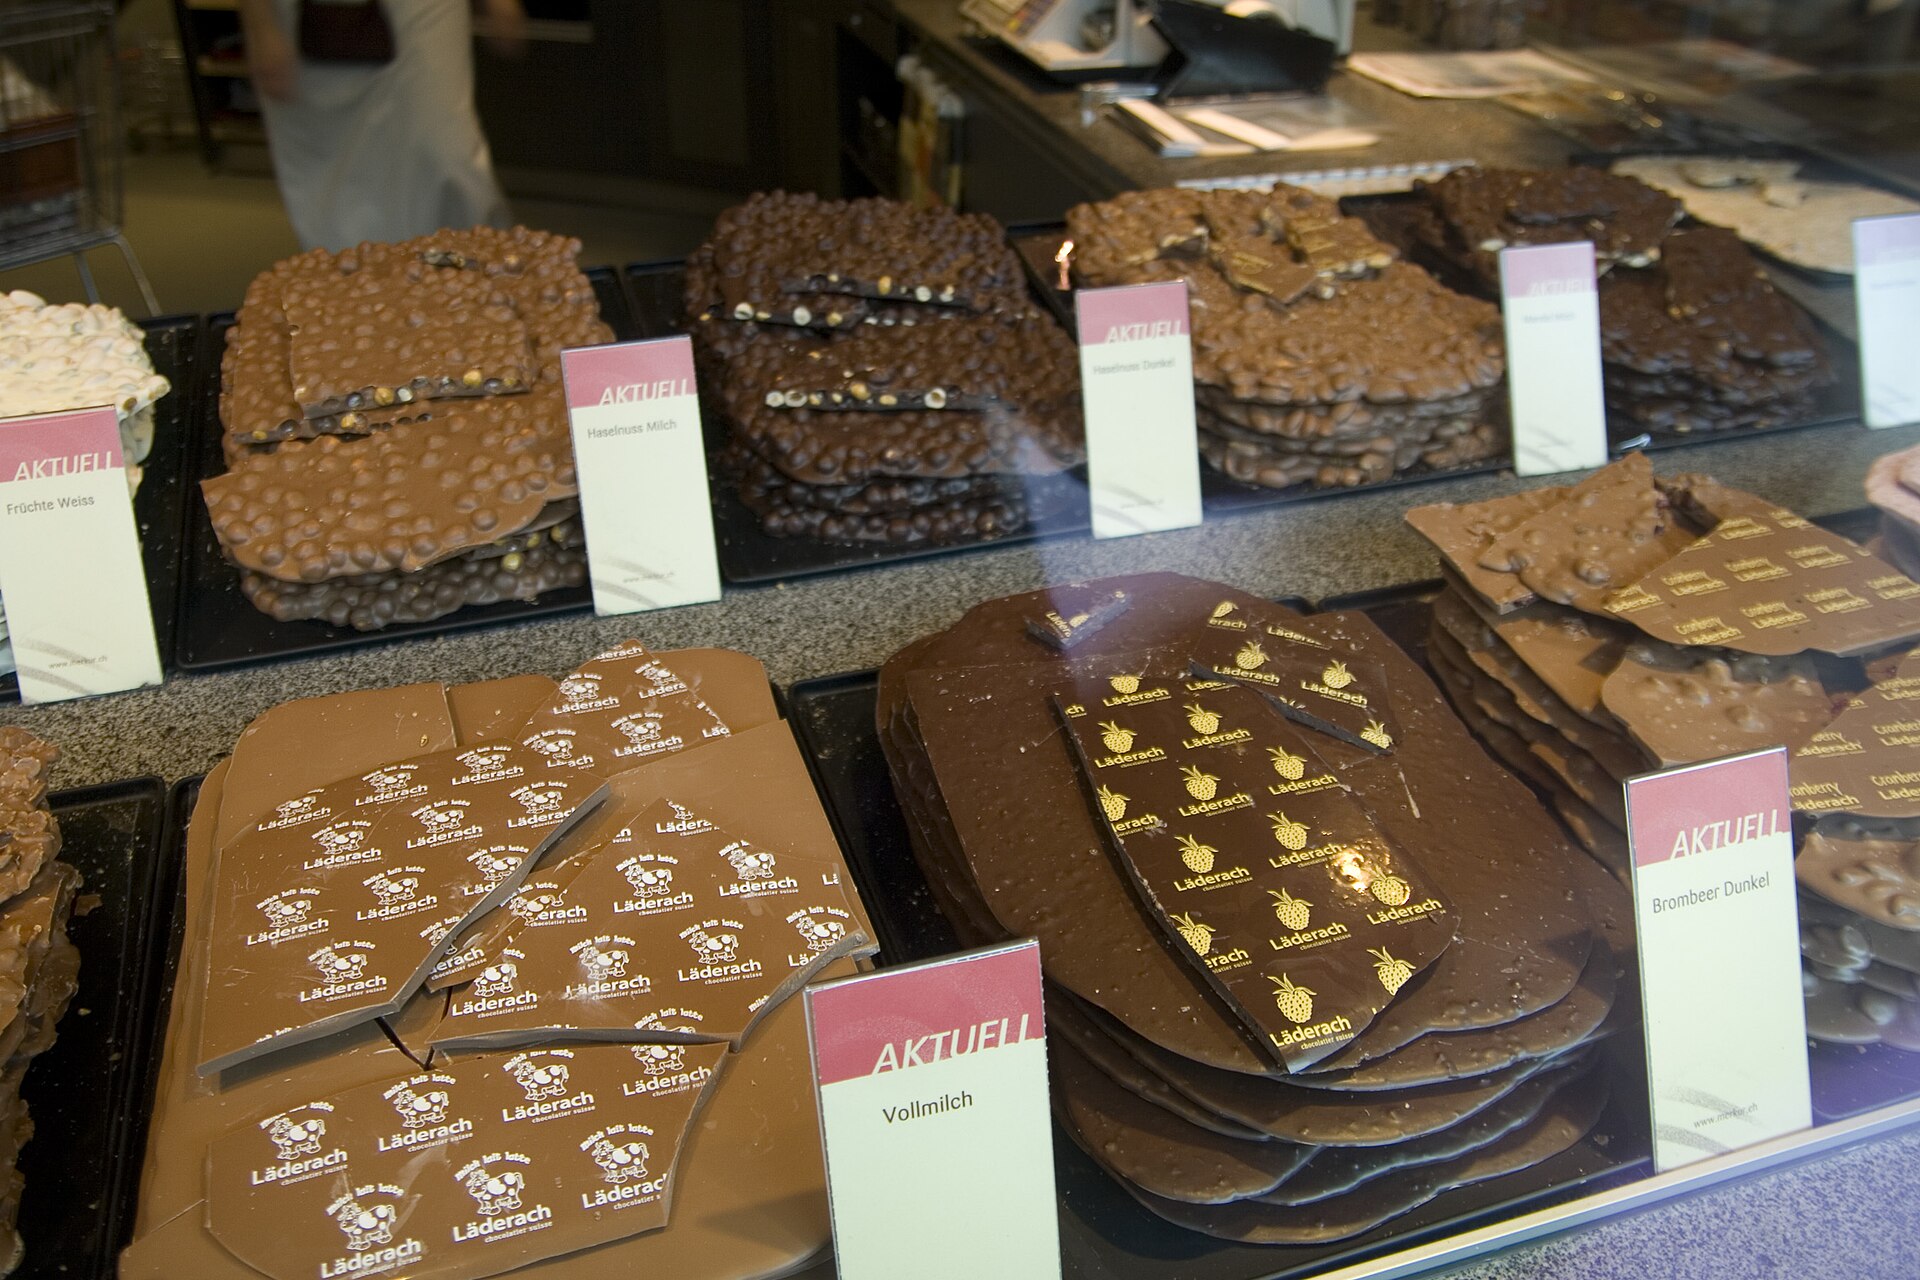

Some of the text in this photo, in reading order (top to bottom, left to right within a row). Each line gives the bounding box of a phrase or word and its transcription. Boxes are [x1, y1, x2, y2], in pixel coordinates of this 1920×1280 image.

[1105, 320, 1181, 344] AKTUELL
[599, 378, 688, 406] AKTUELL
[587, 419, 677, 439] Haselnuss Milch
[14, 451, 113, 481] AKTUELL
[7, 494, 95, 516] Früchte Weiss
[1046, 612, 1072, 638] Lädera
[1208, 618, 1248, 630] erach
[1267, 625, 1324, 645] Läder
[594, 646, 642, 661] derach
[1213, 665, 1280, 684] Läderach
[639, 682, 688, 699] Lädera
[1103, 688, 1170, 707] Läderach
[1301, 681, 1368, 705] Läderach
[553, 696, 619, 715] Läderach
[614, 735, 682, 757] Läderach
[1182, 729, 1251, 750] Läderach
[1094, 747, 1165, 768] Läderach
[452, 765, 524, 786] Läderach
[1268, 774, 1338, 796] Läderach
[355, 784, 428, 806] Läderach
[1790, 782, 1843, 797] ranberry
[1178, 793, 1250, 817] Läderach
[258, 807, 331, 831] Läderach
[655, 819, 713, 834] Lädera
[1111, 814, 1159, 833] erach
[406, 825, 483, 849] Läderach
[1670, 808, 1780, 860] AKTUELL
[303, 847, 382, 870] Läderach
[1268, 843, 1342, 869] Läderach
[718, 876, 798, 897] Läderach
[1174, 866, 1250, 892] Läderach
[613, 891, 694, 914] Läderach
[1652, 871, 1771, 914] Brombeer Dunkel
[356, 894, 438, 921] Läderach
[535, 905, 587, 921] erach
[1366, 898, 1442, 926] Läderach
[247, 918, 329, 946] Läderach
[1269, 922, 1348, 951] Läderach
[428, 948, 485, 975] erach
[678, 958, 762, 983] Läderach
[1204, 948, 1249, 969] erach
[300, 975, 387, 1003] Läderach
[564, 974, 651, 999] Läderach
[452, 990, 538, 1017] Läderach
[1269, 1015, 1352, 1049] Läderach
[871, 1013, 1030, 1076] AKTUELL
[622, 1065, 713, 1097] Läderach
[502, 1091, 595, 1123] Läderach
[882, 1090, 973, 1124] Vollmilch
[1693, 1103, 1758, 1128] www.merkur.ch
[378, 1117, 473, 1152] Läderach
[251, 1148, 348, 1186] Läderach
[452, 1204, 552, 1243] Läderach
[320, 1238, 422, 1279] Läderach
